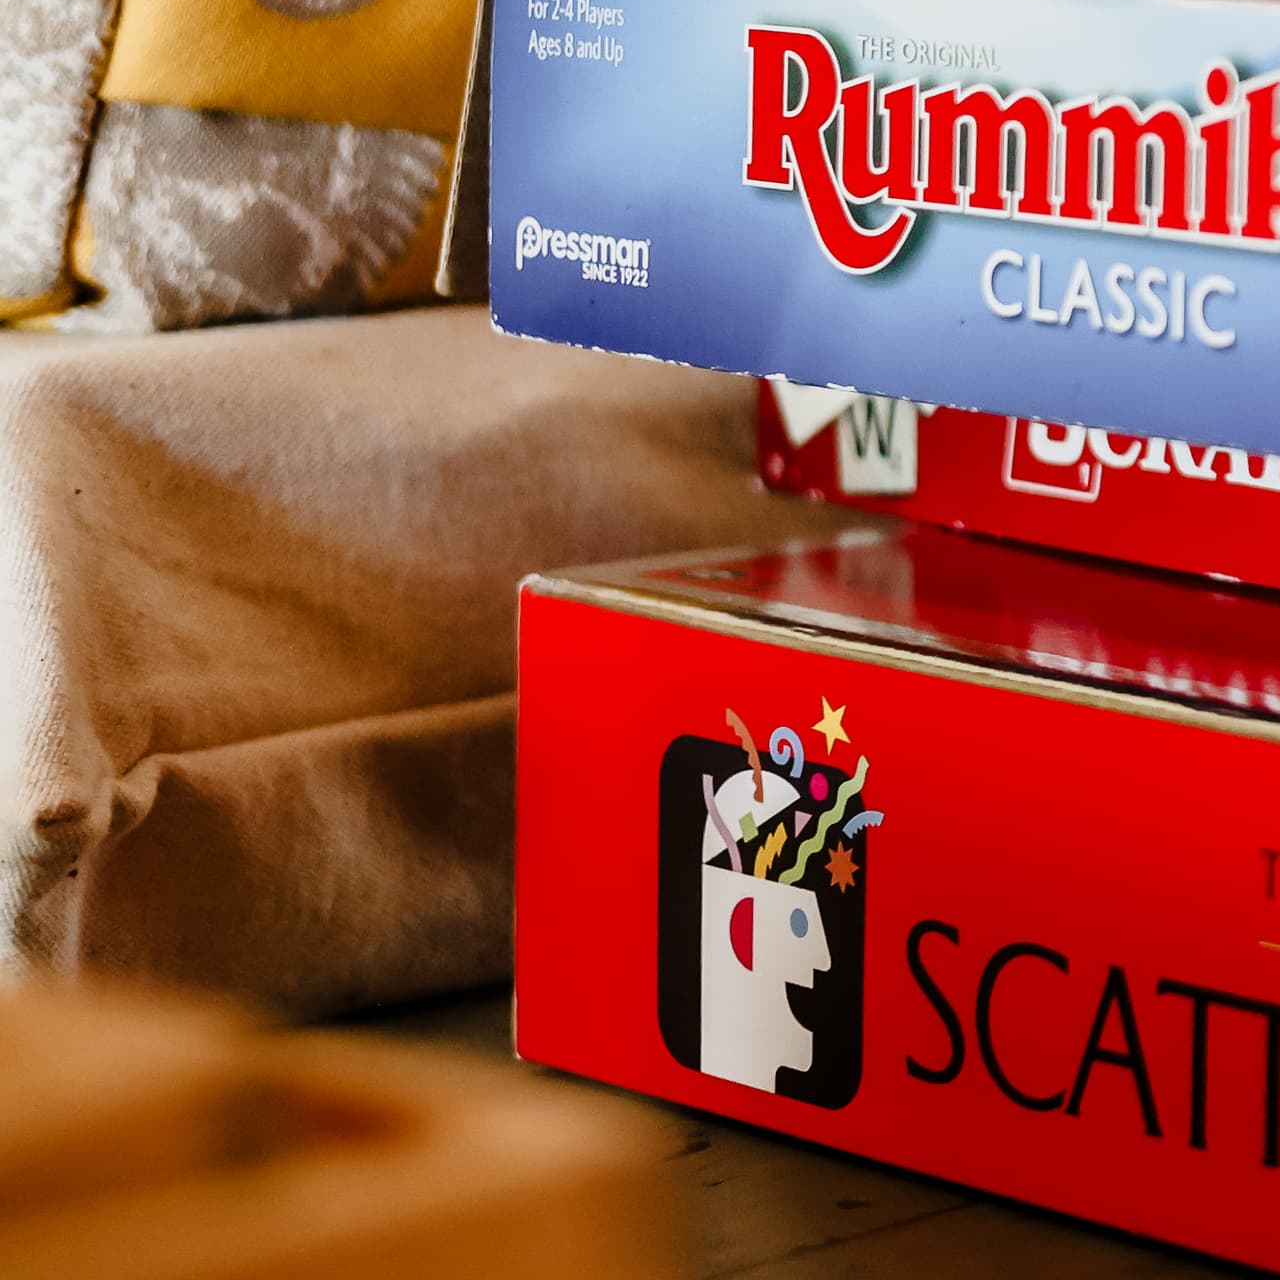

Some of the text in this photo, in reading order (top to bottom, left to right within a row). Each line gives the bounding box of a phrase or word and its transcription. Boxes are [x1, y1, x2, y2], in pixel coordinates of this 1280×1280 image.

[528, 29, 625, 67] Ages 8 and Up
[856, 34, 1001, 71] THE ORIGINAL
[582, 261, 649, 288] SINCE 1922
[981, 249, 1237, 349] CLASSIC
